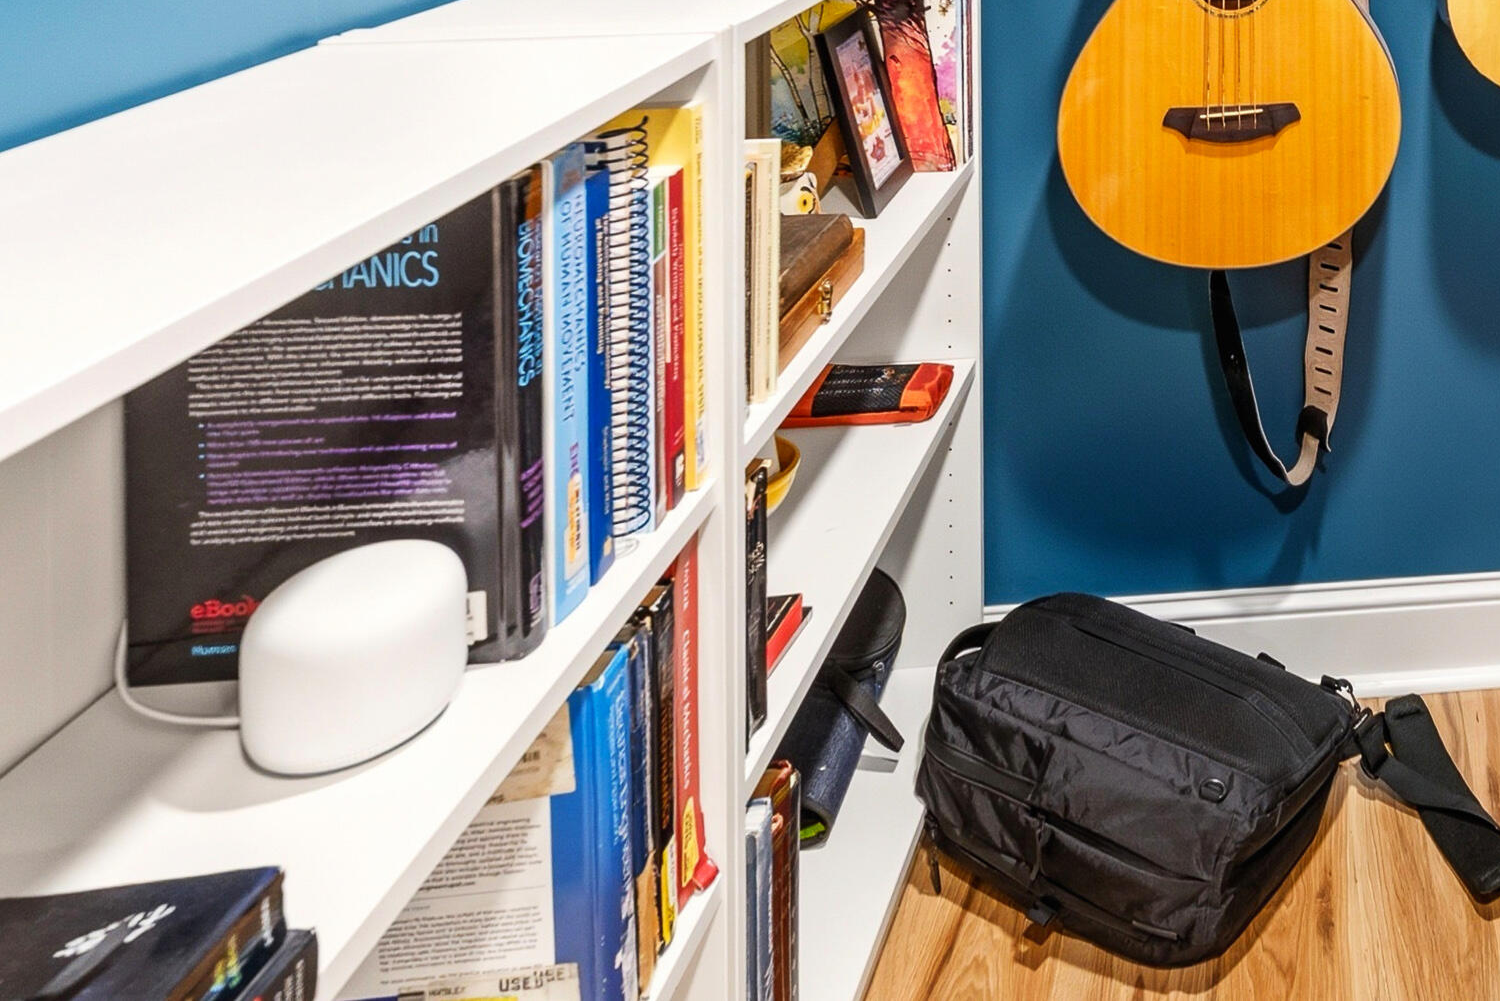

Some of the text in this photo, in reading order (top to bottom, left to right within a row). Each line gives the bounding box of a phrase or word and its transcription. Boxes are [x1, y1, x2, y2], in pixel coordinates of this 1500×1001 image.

[517, 221, 535, 387] BIOMECHANICS
[562, 232, 574, 307] HUMAN
[562, 313, 576, 422] MOVEMENT
